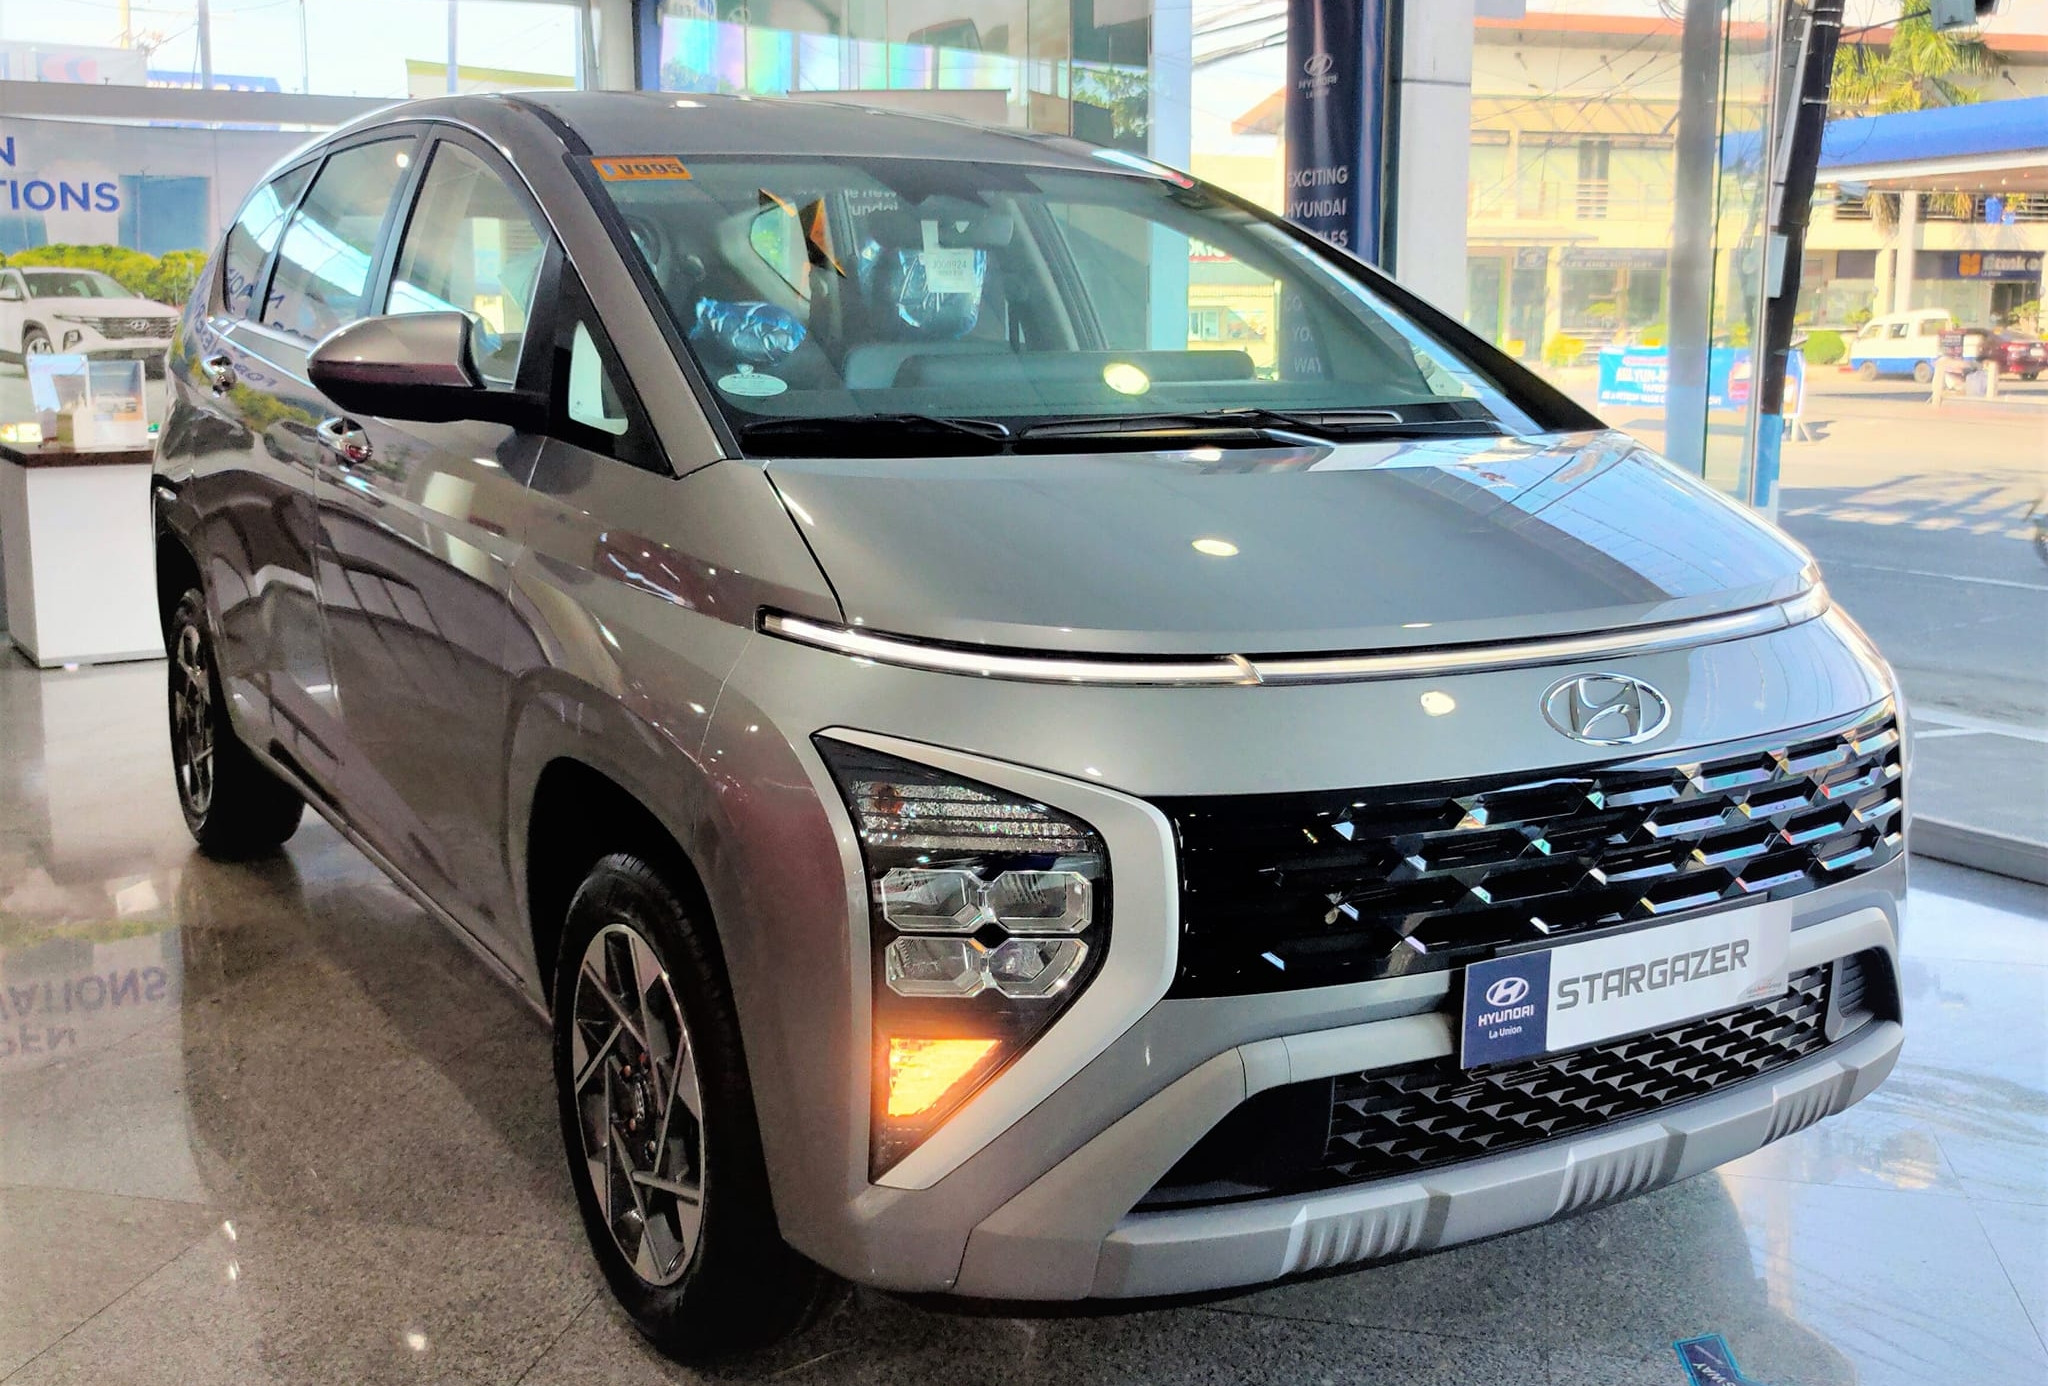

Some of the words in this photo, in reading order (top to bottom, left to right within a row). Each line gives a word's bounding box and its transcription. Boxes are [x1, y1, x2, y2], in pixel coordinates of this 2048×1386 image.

[618, 164, 685, 175] V995
[1287, 167, 1349, 188] EXCITING
[0, 180, 120, 213] IONS
[852, 202, 898, 217] undai
[1287, 198, 1347, 218] HYUNDAI
[1556, 939, 1749, 1010] STARGAZER
[1478, 1004, 1535, 1027] HYUNDAI
[1488, 1030, 1499, 1039] La
[1499, 1025, 1522, 1037] Union
